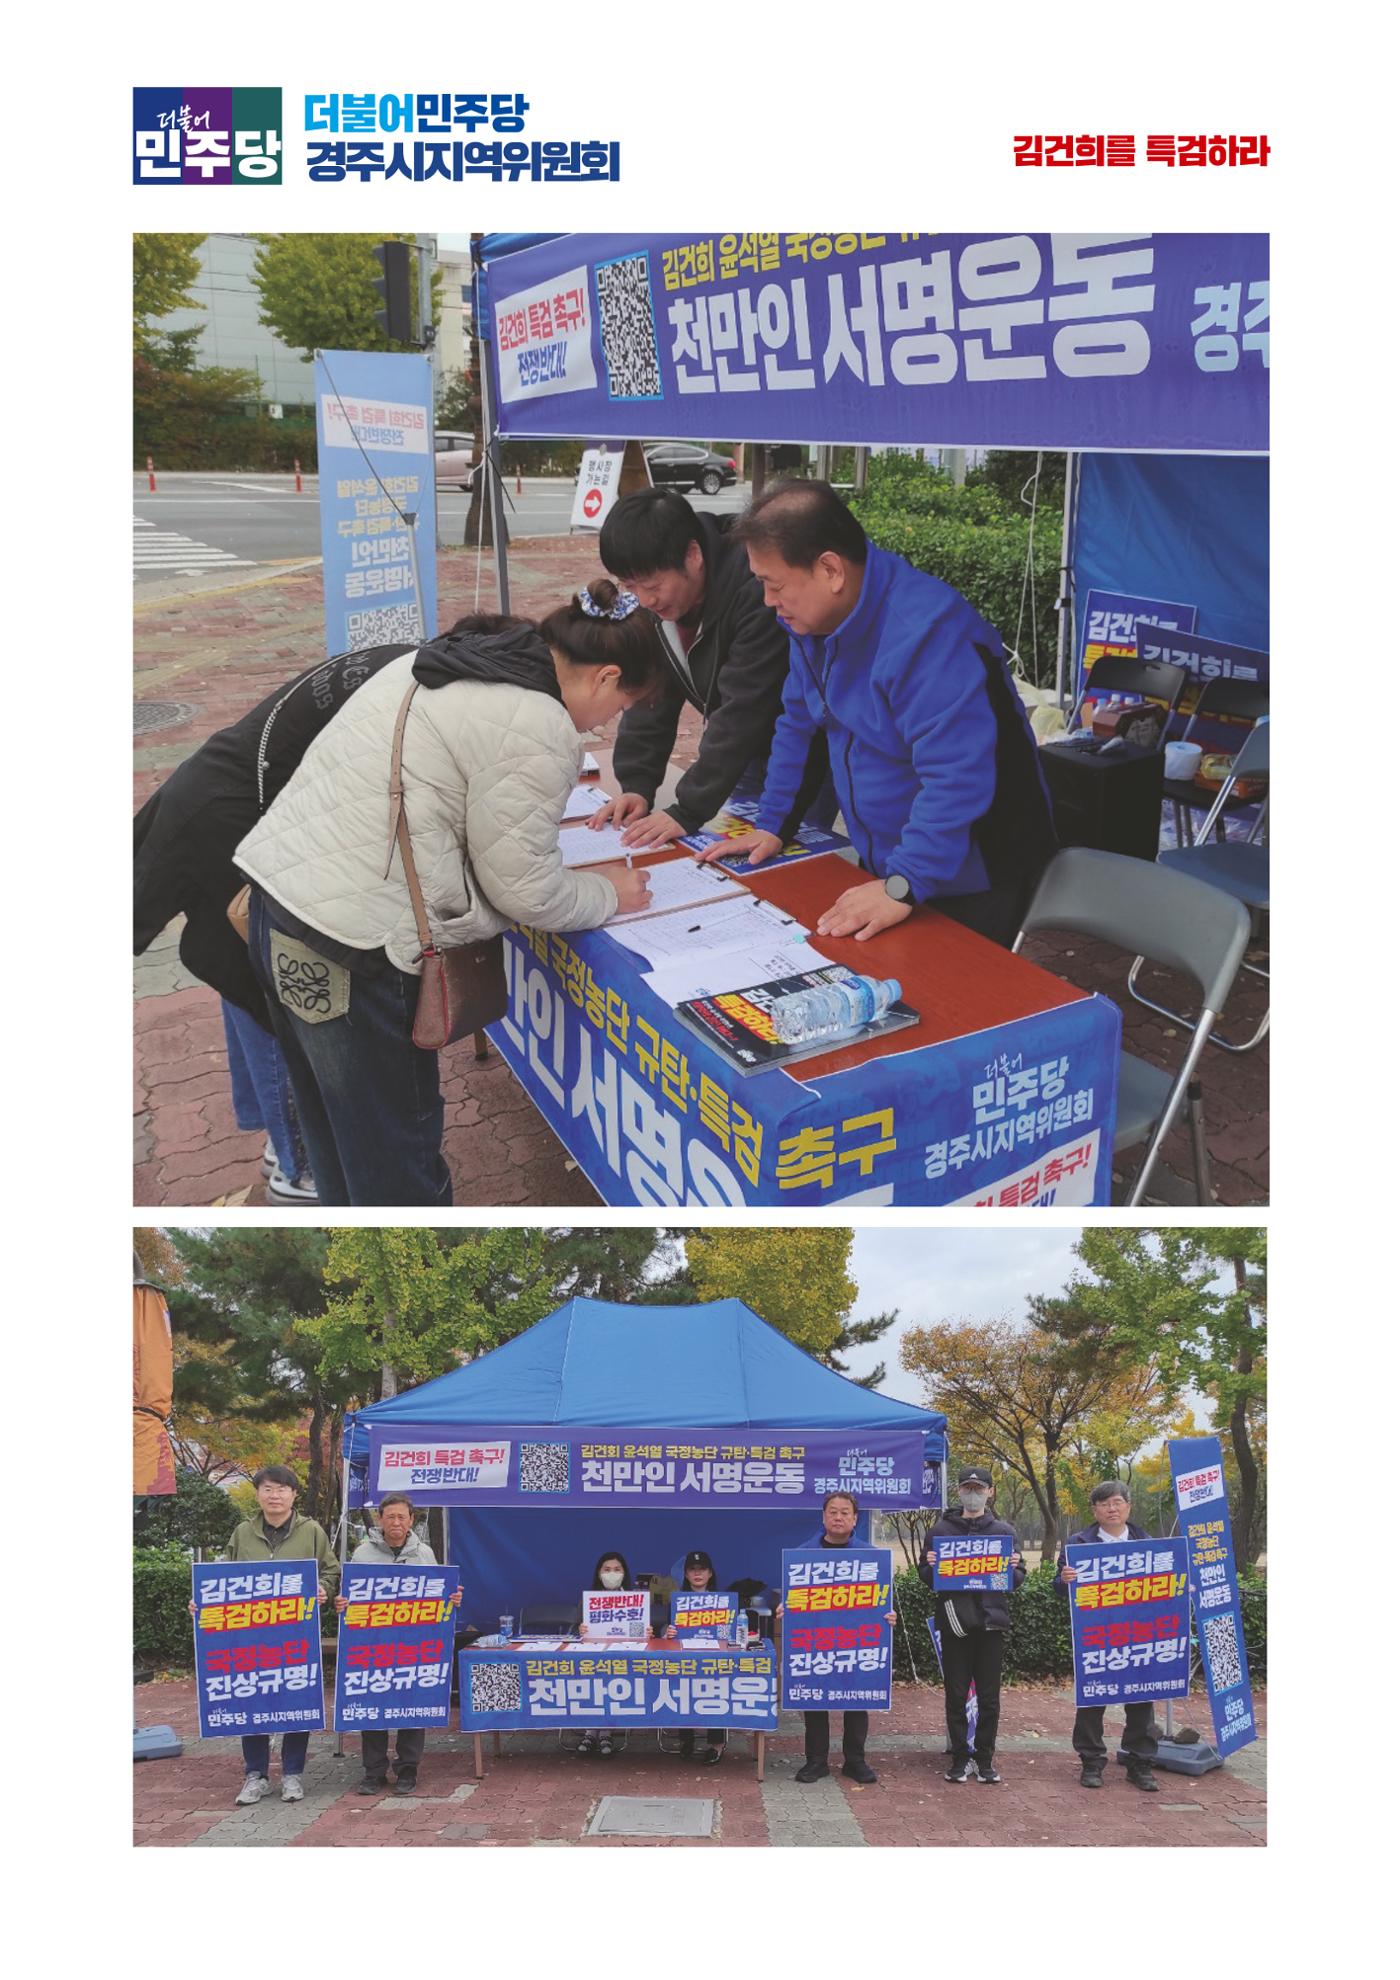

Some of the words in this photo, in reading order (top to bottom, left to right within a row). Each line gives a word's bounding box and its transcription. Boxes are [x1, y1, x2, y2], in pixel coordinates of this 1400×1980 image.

[662, 238, 715, 291] 김건희
[719, 233, 780, 279] 윤석열
[498, 306, 528, 352] 김건희
[529, 299, 553, 341] 특검
[553, 287, 586, 333] 촉구!
[667, 277, 816, 394] 천만인
[824, 233, 1156, 387] 서명운동
[517, 340, 568, 387] 전쟁반대!
[551, 931, 630, 1056] 국정농단
[634, 1015, 763, 1188] 규탄·특검
[775, 1107, 897, 1190] 촉구
[972, 1055, 1070, 1126] 민주당
[924, 1088, 1094, 1180] 경주시지역위원회
[1043, 1143, 1092, 1186] 촉구!
[384, 1451, 431, 1467] 김건희
[434, 1449, 465, 1466] 특검
[468, 1448, 505, 1466] 촉구!
[580, 1445, 621, 1459] 김건희
[623, 1445, 663, 1460] 윤석열
[665, 1445, 718, 1460] 국정농단
[779, 1446, 806, 1460] 촉구
[838, 1456, 896, 1476] 민주당
[410, 1468, 479, 1485] 전쟁반대!
[581, 1461, 675, 1493] 천만인
[679, 1461, 806, 1494] 서명운동
[814, 1477, 912, 1495] 경주시지역위원회
[939, 1539, 1003, 1558] 김건희를
[788, 1559, 880, 1586] 김건희를
[938, 1556, 1010, 1577] 특검하라!
[1074, 1550, 1174, 1583] 김건희를
[200, 1572, 303, 1604] 김건희를
[348, 1575, 446, 1601] 김건희를
[588, 1594, 644, 1611] 전쟁반대!
[676, 1594, 730, 1611] 김건희를
[785, 1583, 890, 1611] 특검하라!
[1074, 1573, 1187, 1609] 특검하라!
[198, 1597, 316, 1630] 특검하라!
[344, 1600, 454, 1627] 특검하라!
[589, 1608, 643, 1624] 평화수호!
[674, 1609, 736, 1627] 특검하라!
[789, 1623, 884, 1652] 국정농단
[1081, 1615, 1180, 1649] 국정농단
[205, 1639, 311, 1674] 국정농단
[346, 1639, 445, 1671] 국정농단
[526, 1659, 575, 1676] 김건희
[578, 1658, 628, 1675] 윤석열
[632, 1658, 698, 1676] 국정농단
[701, 1657, 771, 1675] 규탄·특검
[788, 1646, 888, 1677] 진상규명!
[1081, 1636, 1188, 1675] 진상규명!
[205, 1663, 318, 1702] 진상규명!
[343, 1662, 450, 1697] 진상규명!
[788, 1687, 823, 1701] 민주당
[1082, 1684, 1119, 1697] 민주당
[528, 1677, 647, 1717] 천만인
[652, 1677, 777, 1718] 서명운
[207, 1711, 248, 1727] 민주당
[342, 1706, 380, 1721] 민주당
